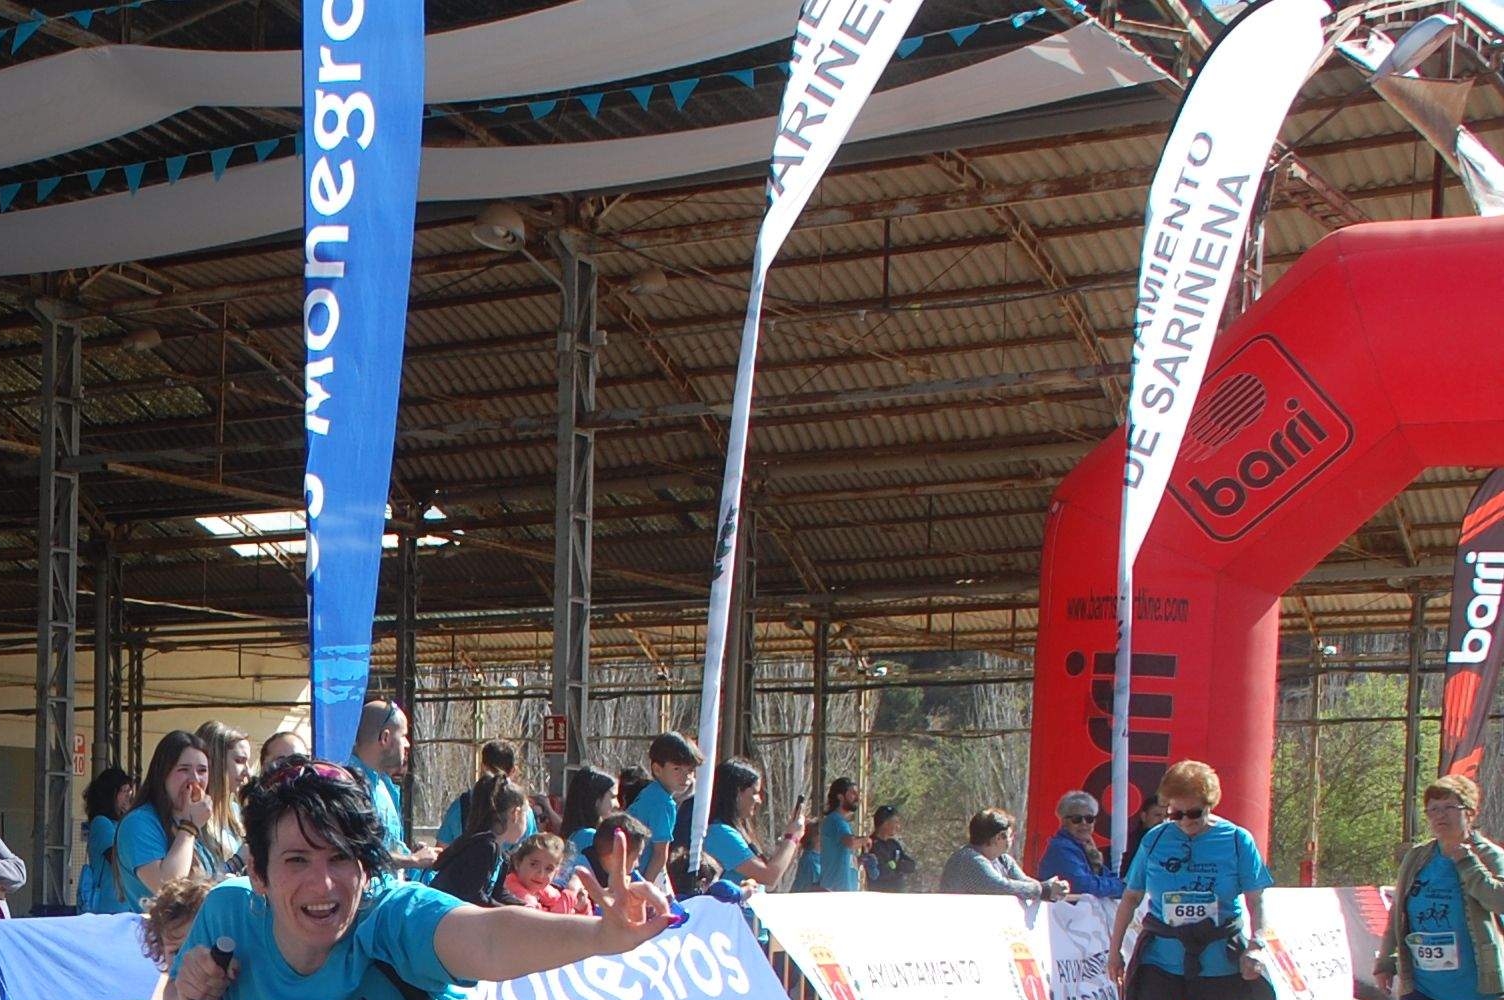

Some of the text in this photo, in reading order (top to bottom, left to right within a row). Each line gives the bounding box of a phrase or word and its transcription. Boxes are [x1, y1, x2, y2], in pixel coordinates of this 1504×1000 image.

[1133, 131, 1214, 362] AMIENTO
[1141, 173, 1251, 415] SARIÑENA
[1187, 397, 1328, 517] barri
[1448, 551, 1504, 664] barri
[1175, 905, 1207, 917] 688
[1418, 946, 1445, 959] 693
